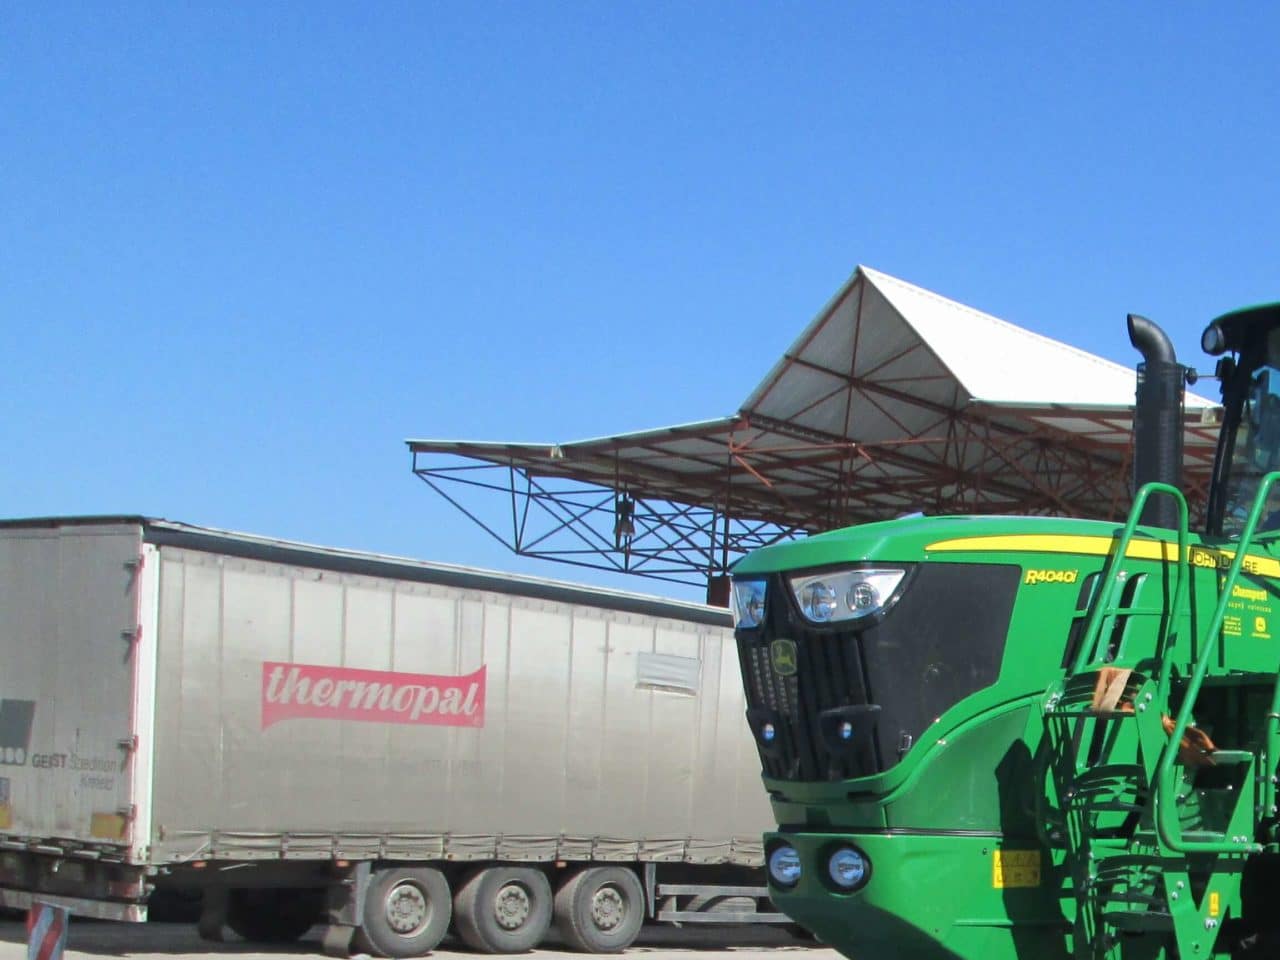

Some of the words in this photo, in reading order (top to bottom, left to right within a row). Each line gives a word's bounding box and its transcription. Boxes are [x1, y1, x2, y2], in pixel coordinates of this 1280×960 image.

[1024, 568, 1079, 585] R4040i
[266, 665, 480, 720] thermopal
[31, 753, 67, 769] GEIST
